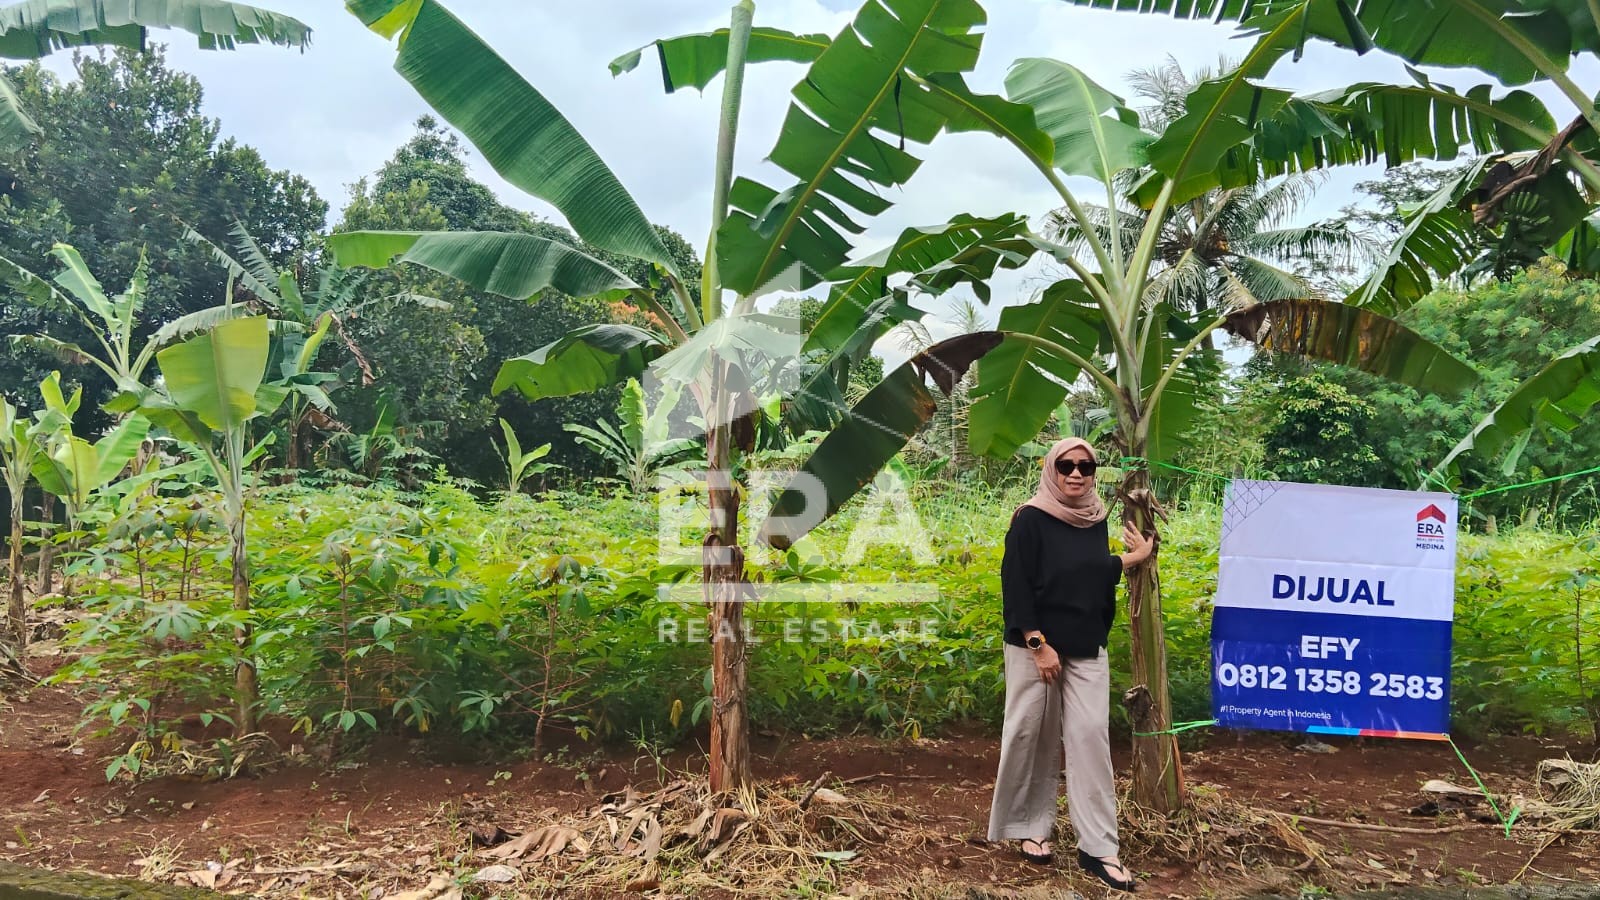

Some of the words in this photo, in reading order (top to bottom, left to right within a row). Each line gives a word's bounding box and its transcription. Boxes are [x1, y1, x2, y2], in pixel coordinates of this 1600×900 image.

[1417, 523, 1444, 535] ERA
[1272, 574, 1395, 606] DIJUAL
[1301, 635, 1360, 660] EFY
[1218, 663, 1287, 690] 0812
[1295, 668, 1361, 695] 1358
[1369, 673, 1444, 700] 2583
[1220, 705, 1229, 713] #1
[1229, 705, 1261, 716] Property
[1263, 708, 1286, 717] Agent
[1287, 709, 1294, 717] in
[1295, 710, 1332, 720] Indonesia
